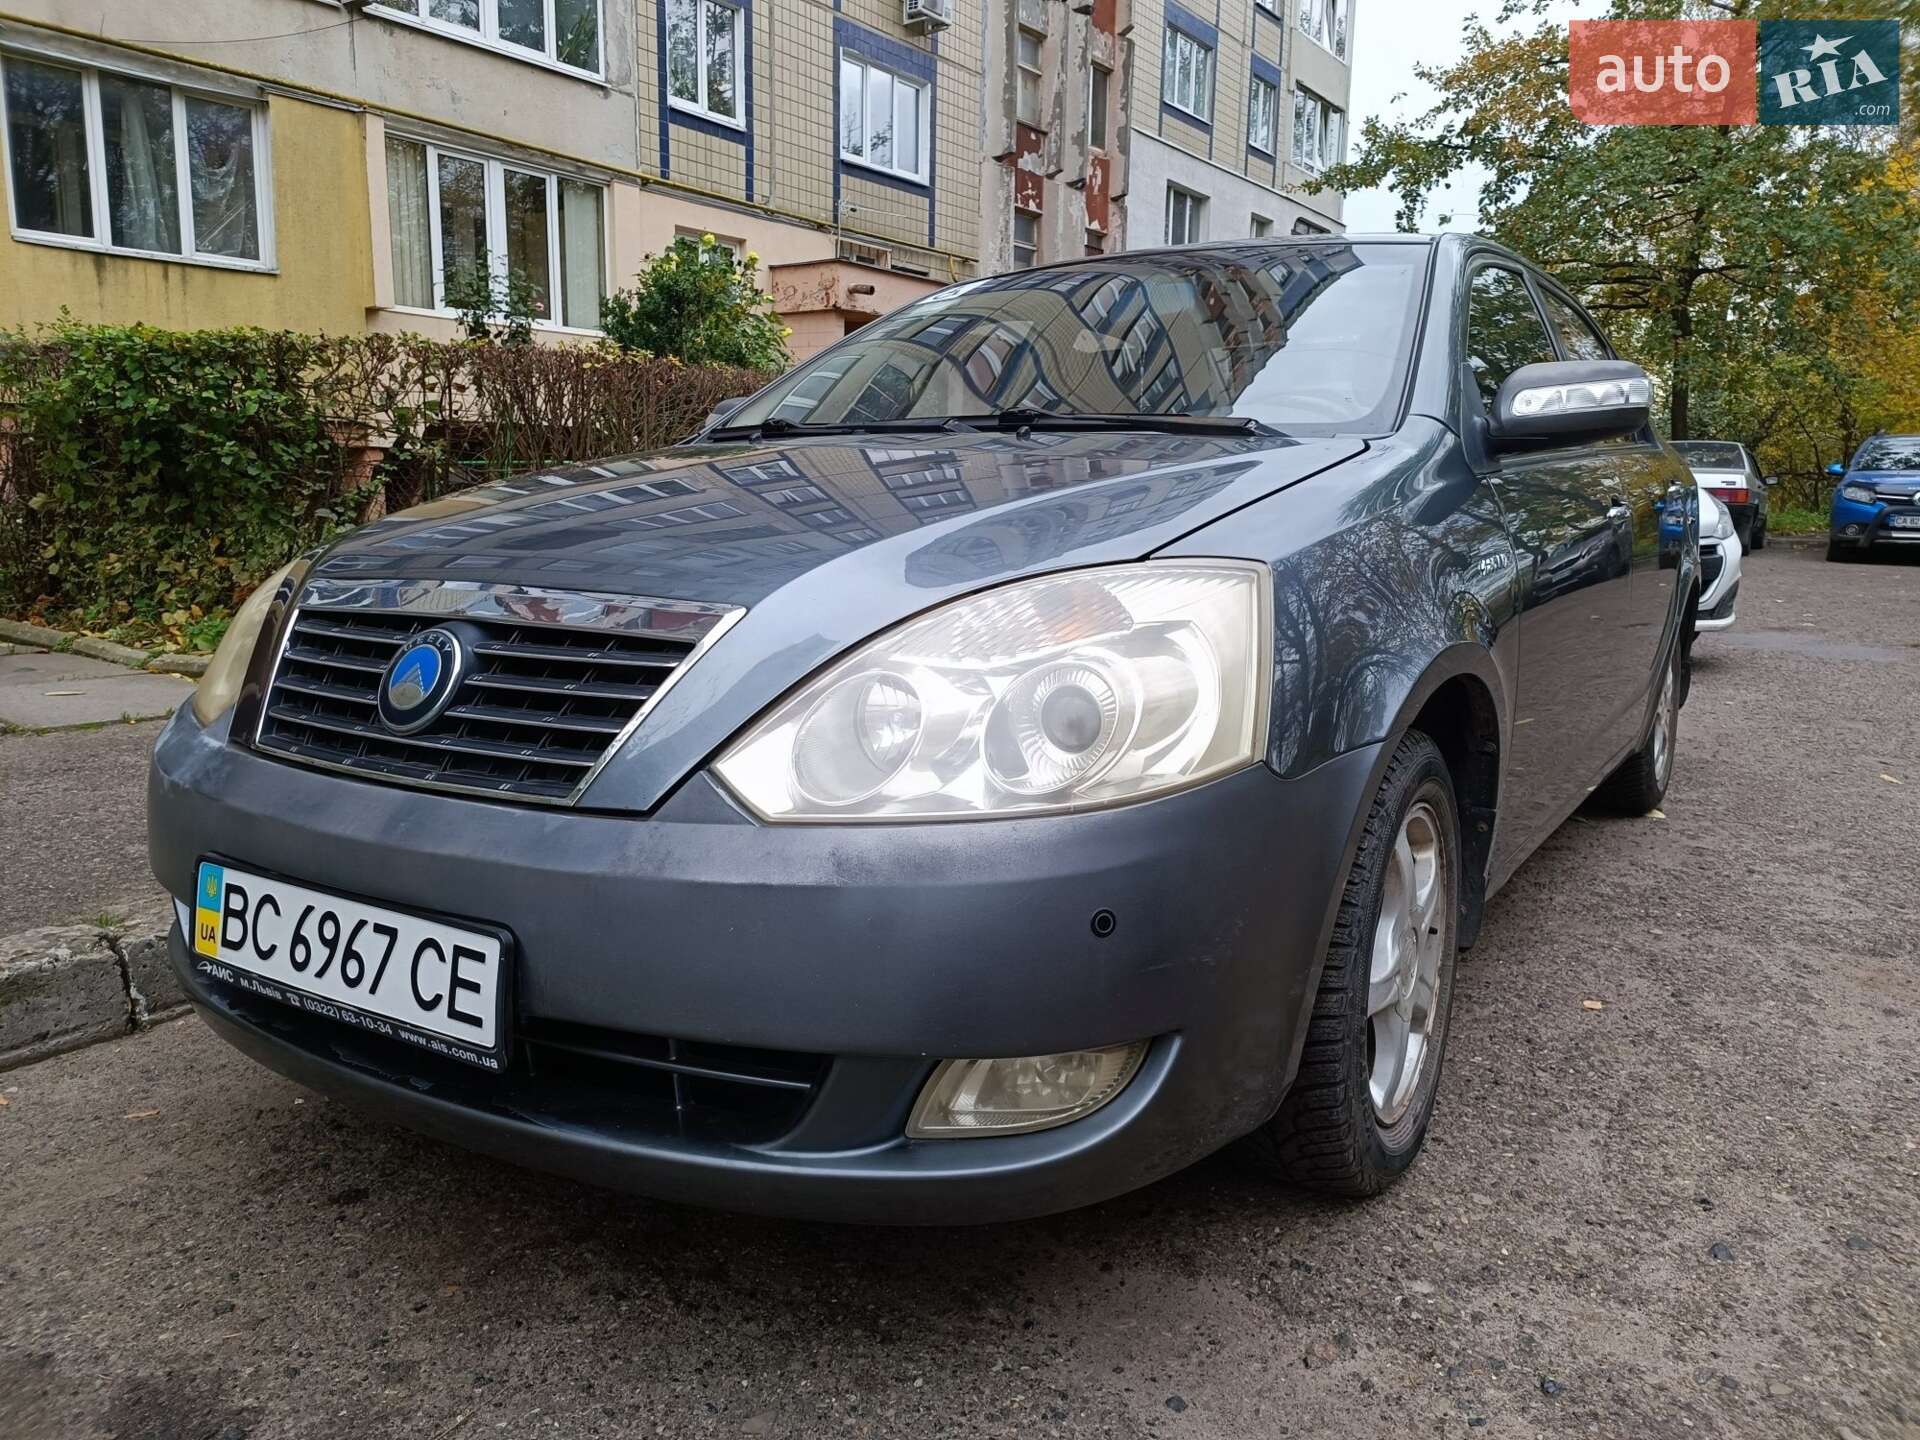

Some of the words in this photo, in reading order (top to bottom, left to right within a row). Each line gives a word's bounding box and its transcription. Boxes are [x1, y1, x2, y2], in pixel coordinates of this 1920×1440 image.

[200, 924, 217, 944] UA
[221, 882, 282, 961] BC
[289, 904, 399, 995] 6967
[410, 937, 487, 1029] CE
[303, 997, 340, 1020] (0322)
[341, 1009, 393, 1036] 63-10-34
[398, 1029, 499, 1070] www.ais.com.ua
